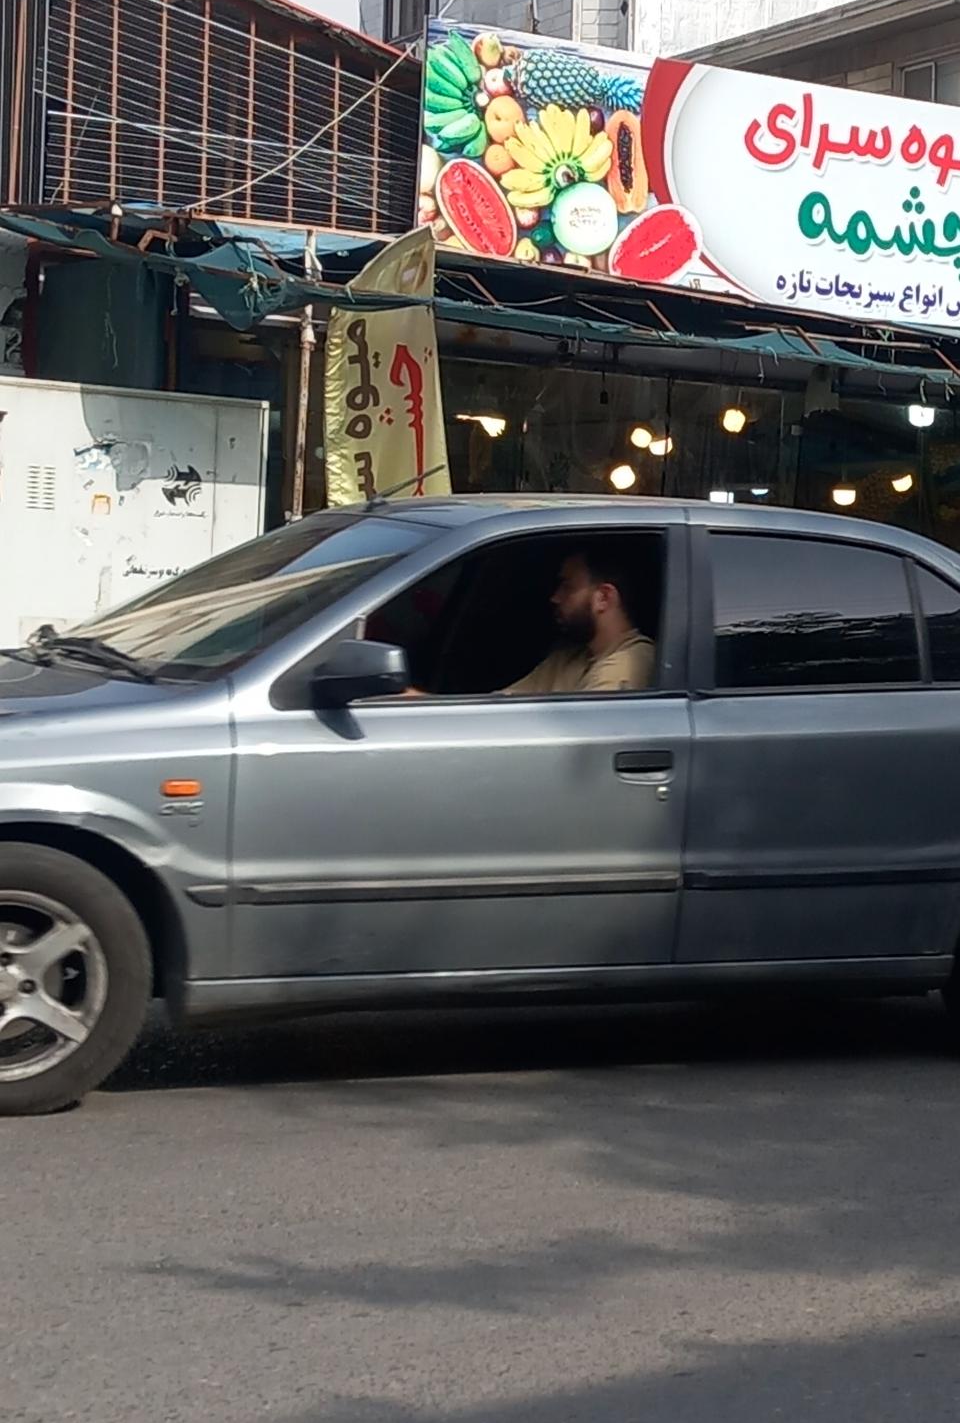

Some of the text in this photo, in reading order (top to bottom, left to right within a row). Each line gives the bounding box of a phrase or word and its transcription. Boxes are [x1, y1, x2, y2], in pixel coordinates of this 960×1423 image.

[744, 93, 893, 170] سرای
[776, 269, 813, 299] تازه
[815, 274, 895, 307] سبزیجات
[899, 284, 943, 314] انواع
[345, 318, 381, 439] میوه
